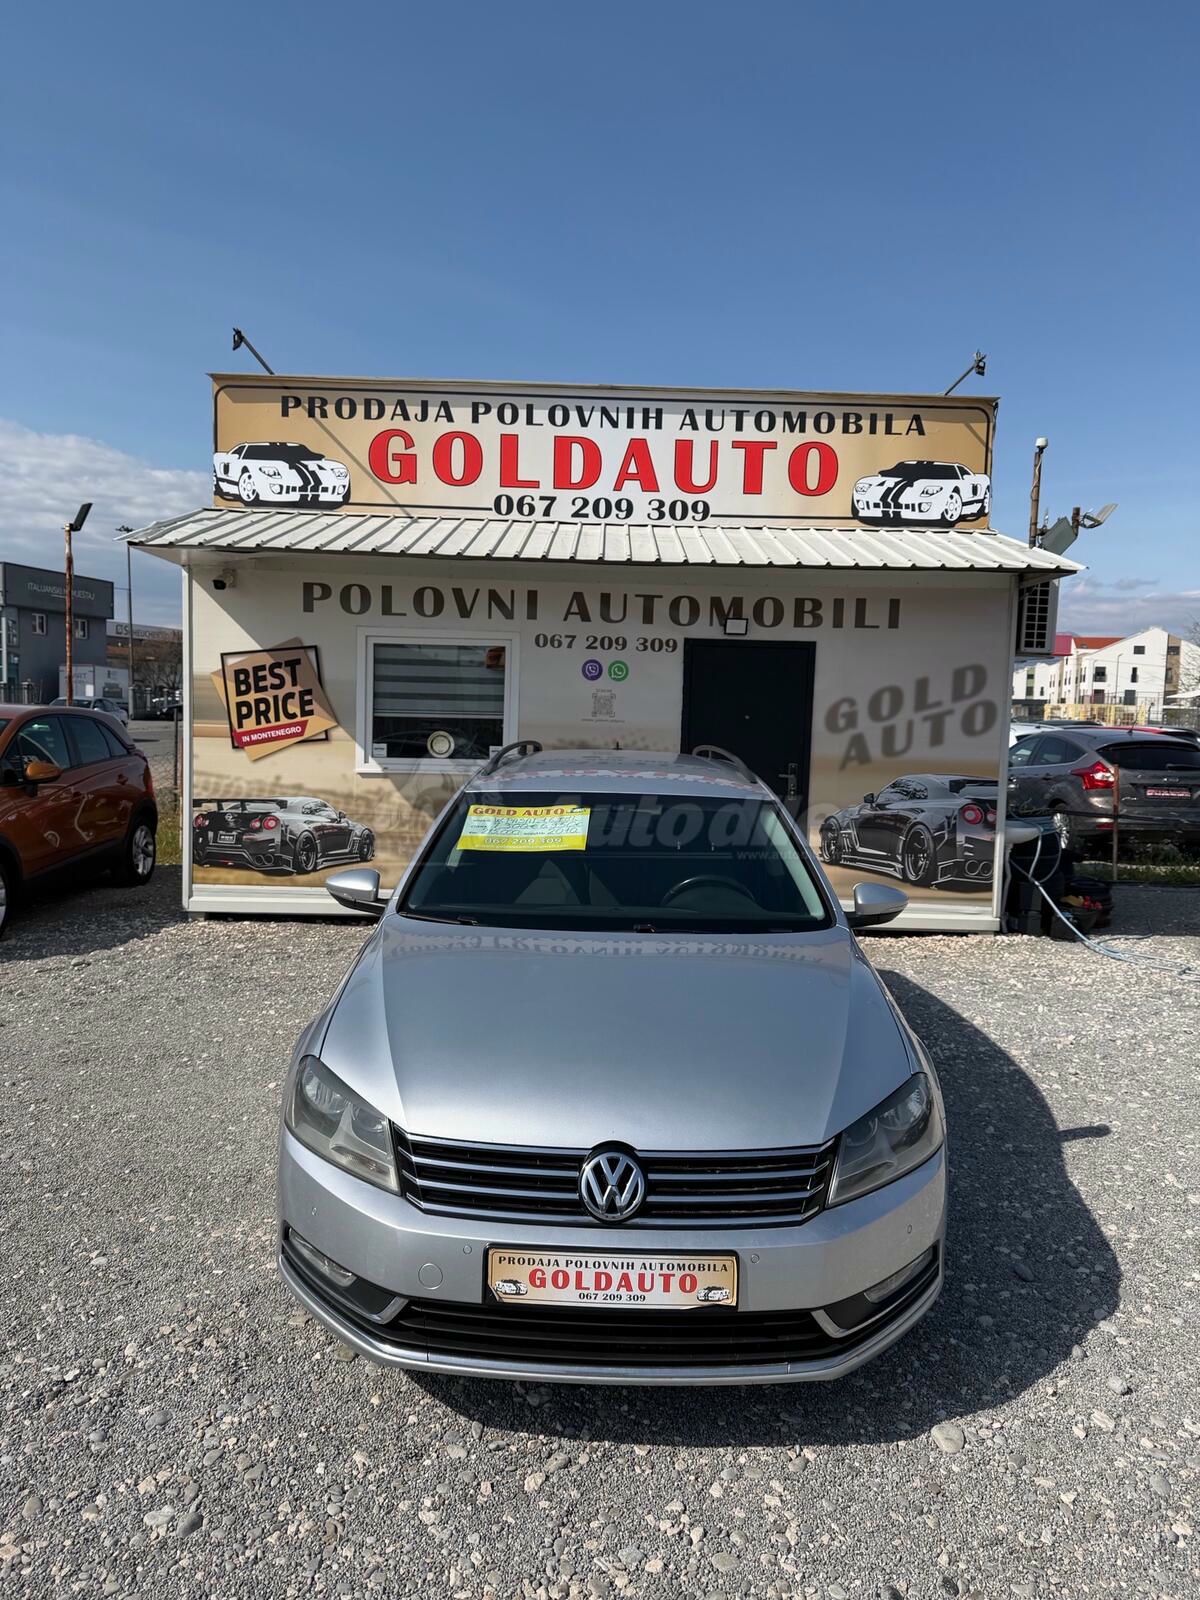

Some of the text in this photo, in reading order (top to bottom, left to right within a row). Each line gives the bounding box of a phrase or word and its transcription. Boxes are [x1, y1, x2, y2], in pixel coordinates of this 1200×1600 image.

[281, 395, 926, 436] PRODAJA POLOVNIH AUTOMOBILA
[368, 429, 839, 496] GOLDAUTO
[493, 494, 711, 522] 067 209 309
[302, 582, 901, 629] POLOVNI AUTOMOBILI
[534, 633, 678, 653] 067 209 309
[233, 658, 302, 697] BEST
[233, 688, 314, 729] PRICE
[824, 663, 988, 734] GOLD
[242, 726, 302, 743] IN MONTENEGRO
[839, 699, 998, 771] AUTO
[473, 807, 565, 816] GOLD AUTO
[498, 1255, 728, 1272] PRODAJA POLOVNIH AUTOMOBILA
[528, 1268, 698, 1293] GOLDAUTO
[579, 1292, 646, 1302] 067 209 309
